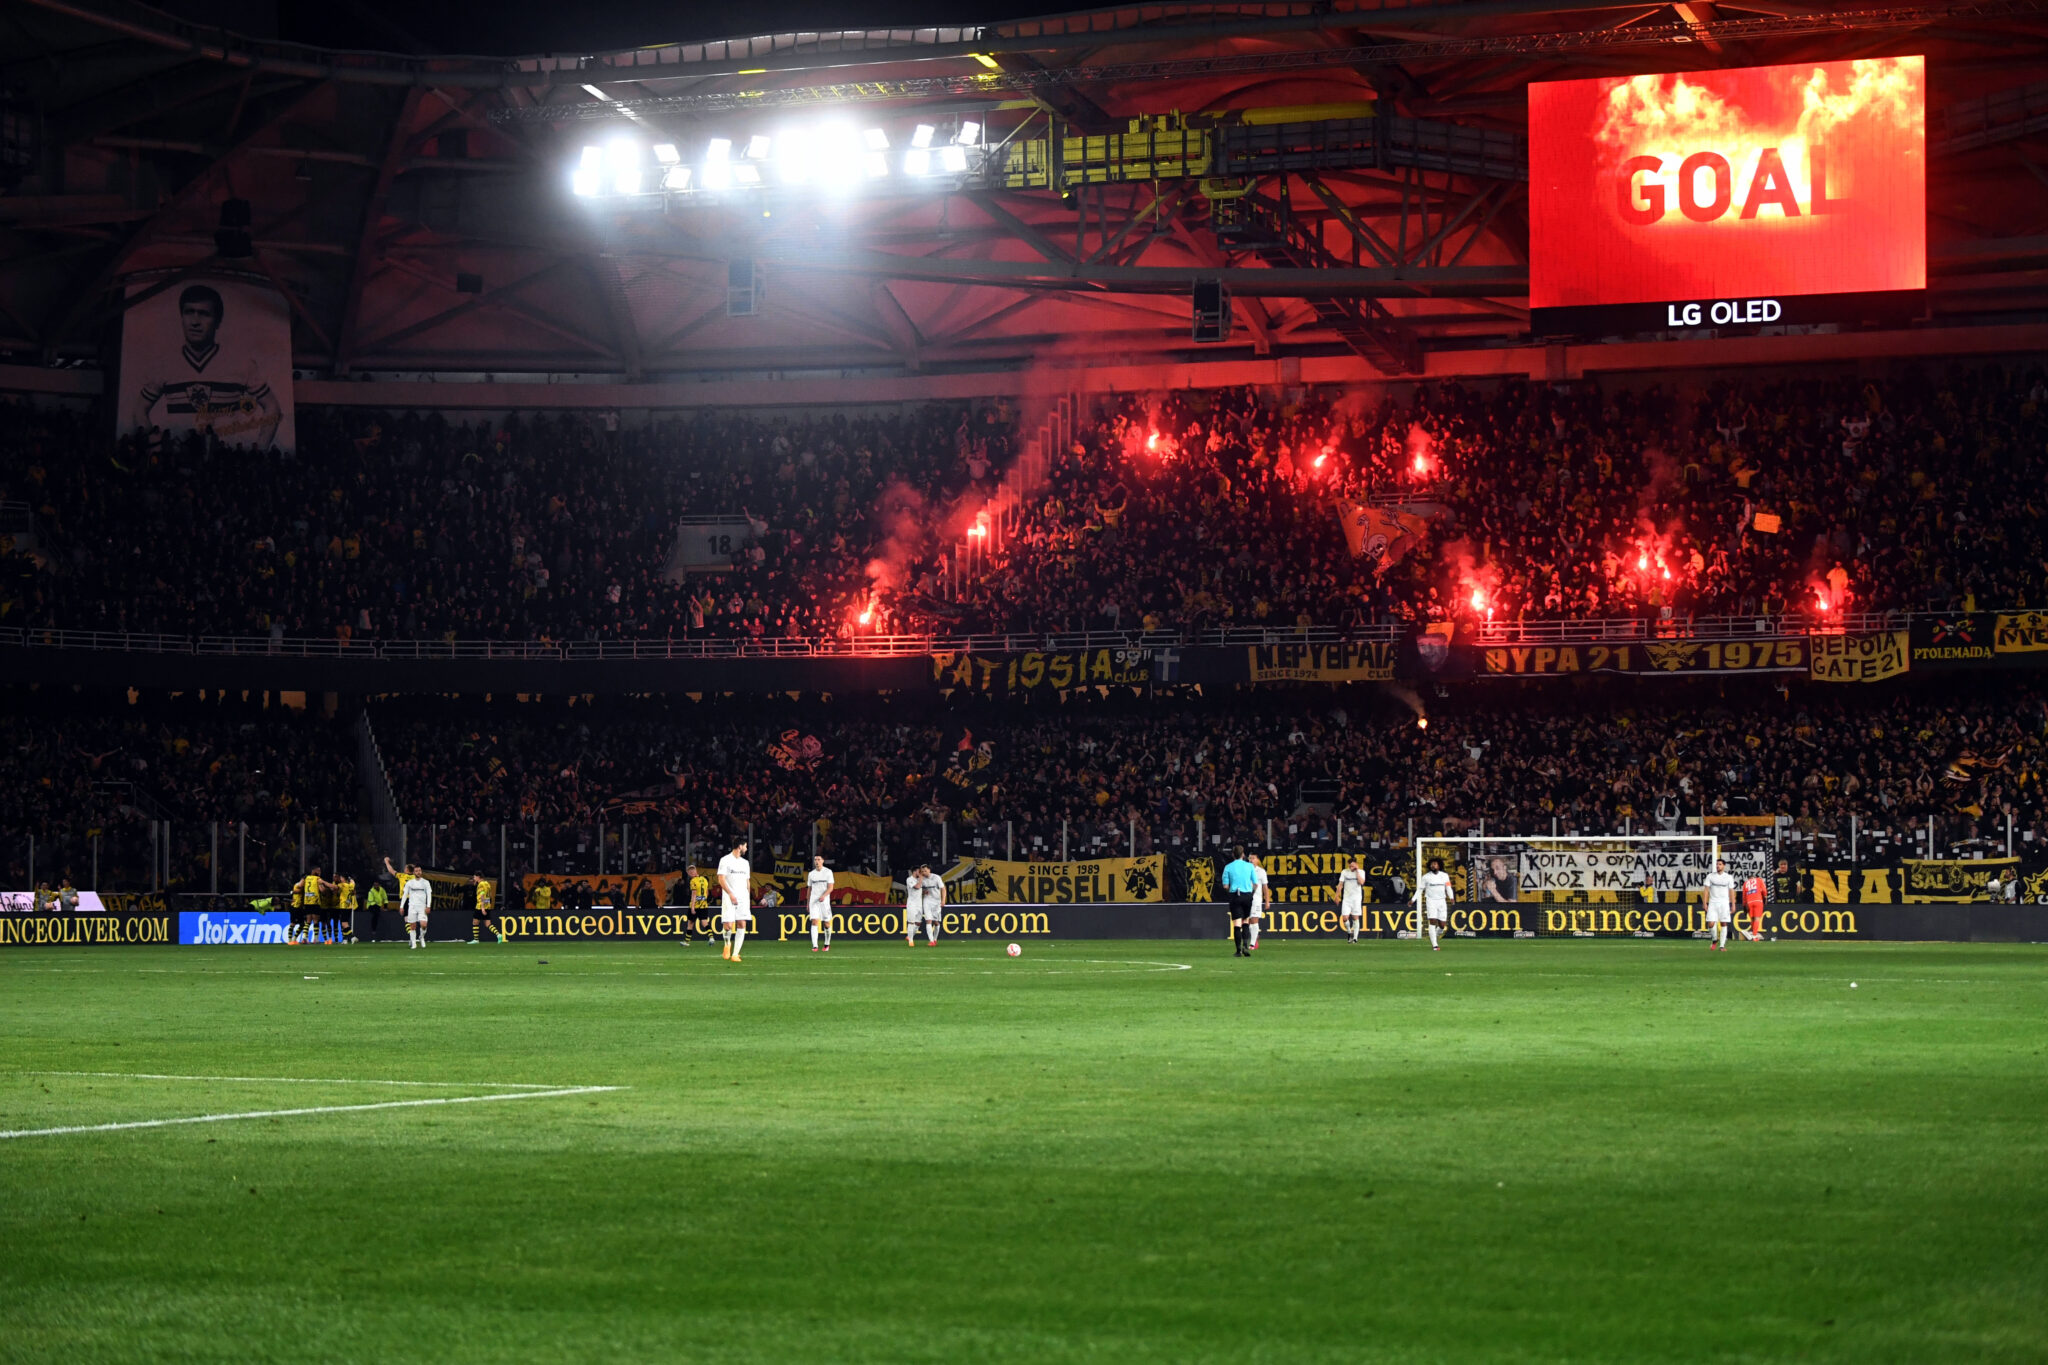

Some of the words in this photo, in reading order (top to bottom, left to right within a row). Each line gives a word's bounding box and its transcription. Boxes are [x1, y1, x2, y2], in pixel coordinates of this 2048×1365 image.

[1617, 145, 1853, 226] GOAL
[1668, 304, 1701, 326] LG
[1711, 300, 1781, 323] OLED
[708, 535, 731, 555] 18
[1588, 646, 1630, 671] 21
[1702, 642, 1803, 667] 1975
[1813, 658, 1877, 679] GATE
[1881, 649, 1903, 671] 21
[1914, 646, 1992, 660] PTOLEMAIDA
[931, 648, 1113, 690] PATISSIA
[1114, 668, 1149, 684] CLUB
[1258, 669, 1291, 680] SINCE
[1294, 669, 1318, 679] 1974
[1028, 865, 1069, 875] SINCE
[1077, 864, 1100, 875] 1989
[1008, 873, 1115, 903] KIPSELI
[1745, 878, 1758, 890] 42
